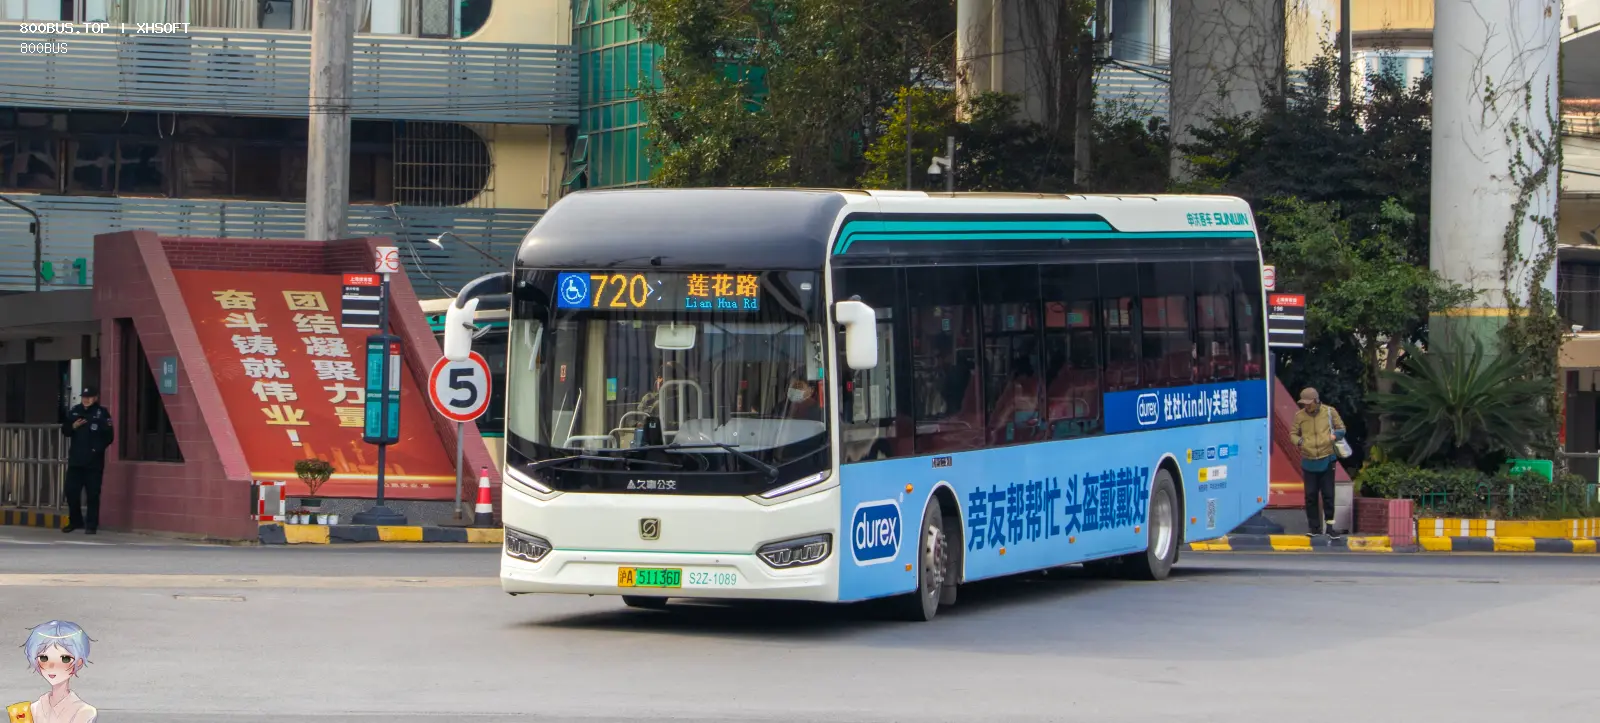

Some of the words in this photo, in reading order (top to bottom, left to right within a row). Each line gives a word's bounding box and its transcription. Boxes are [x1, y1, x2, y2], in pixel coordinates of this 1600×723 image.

[1186, 211, 1213, 227] 申沃客车
[1213, 212, 1249, 226] SUNWIN
[590, 274, 648, 308] 720
[687, 273, 758, 297] 莲花路
[685, 297, 712, 309] Lian
[717, 297, 738, 309] Hua
[743, 297, 758, 309] Rd
[449, 367, 478, 409] 5
[1139, 399, 1157, 418] durex
[968, 476, 1061, 552] 旁友帮帮忙
[1065, 466, 1149, 536] 头盔戴戴好
[856, 511, 898, 550] durex
[689, 572, 737, 586] S2Z-1089
